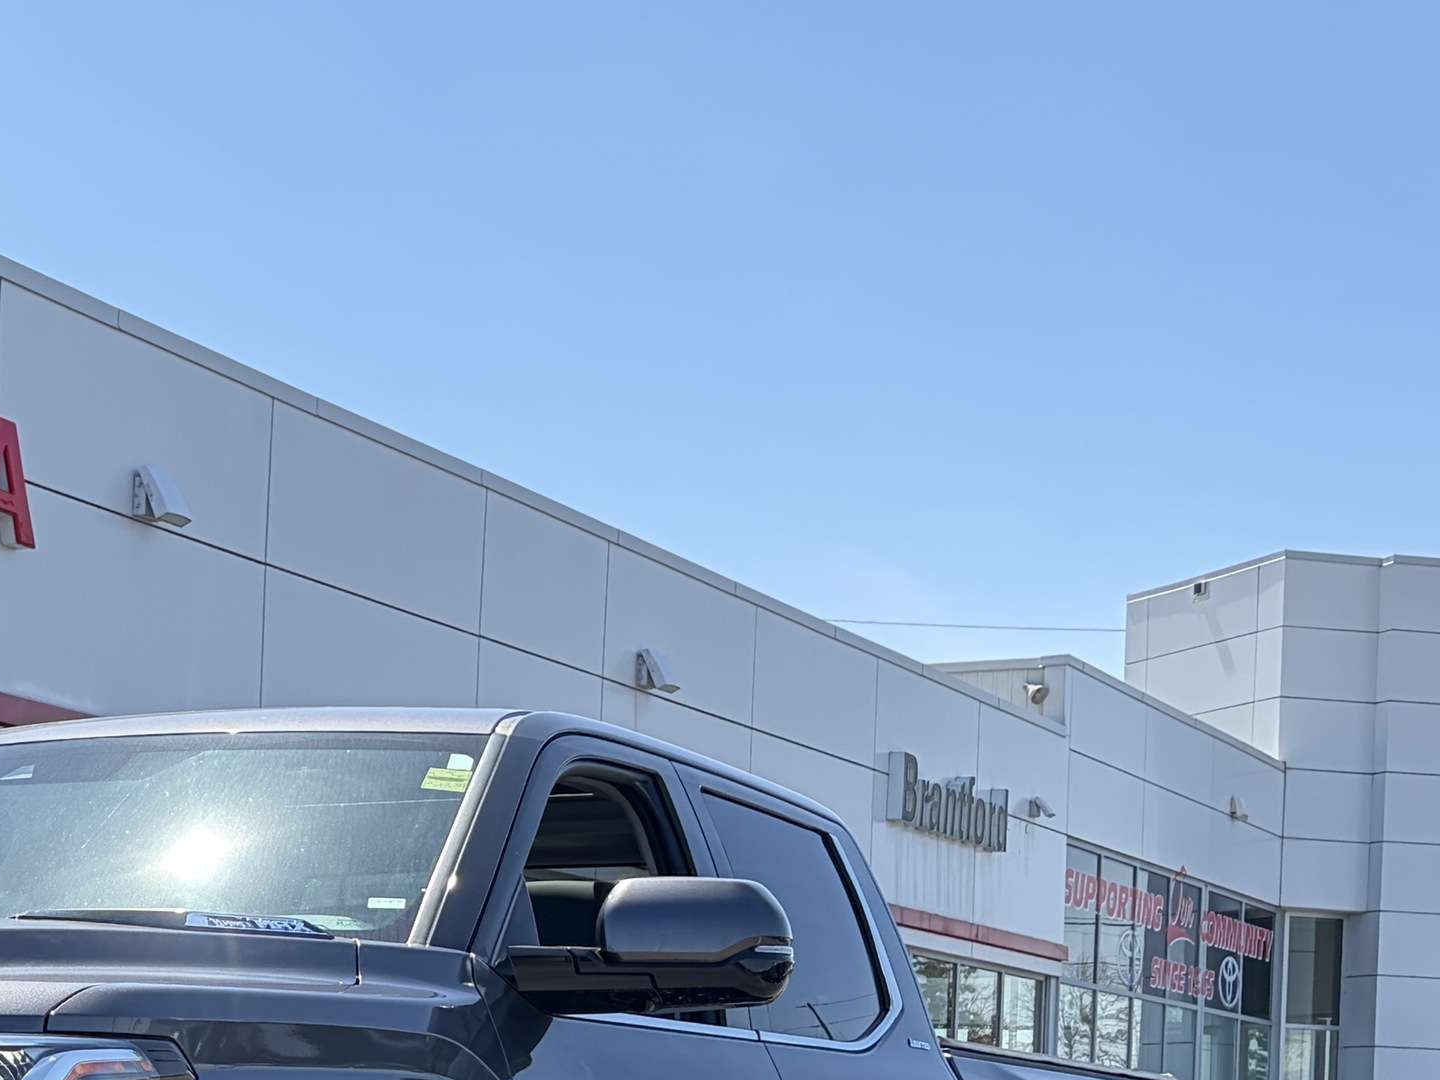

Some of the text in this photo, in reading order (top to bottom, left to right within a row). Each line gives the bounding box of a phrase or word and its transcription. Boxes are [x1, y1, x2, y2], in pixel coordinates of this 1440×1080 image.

[888, 752, 1008, 852] Brantford
[1065, 867, 1164, 932] SUPPORTING
[1201, 911, 1274, 962] COMMUNITY
[1150, 956, 1187, 994] SINCE
